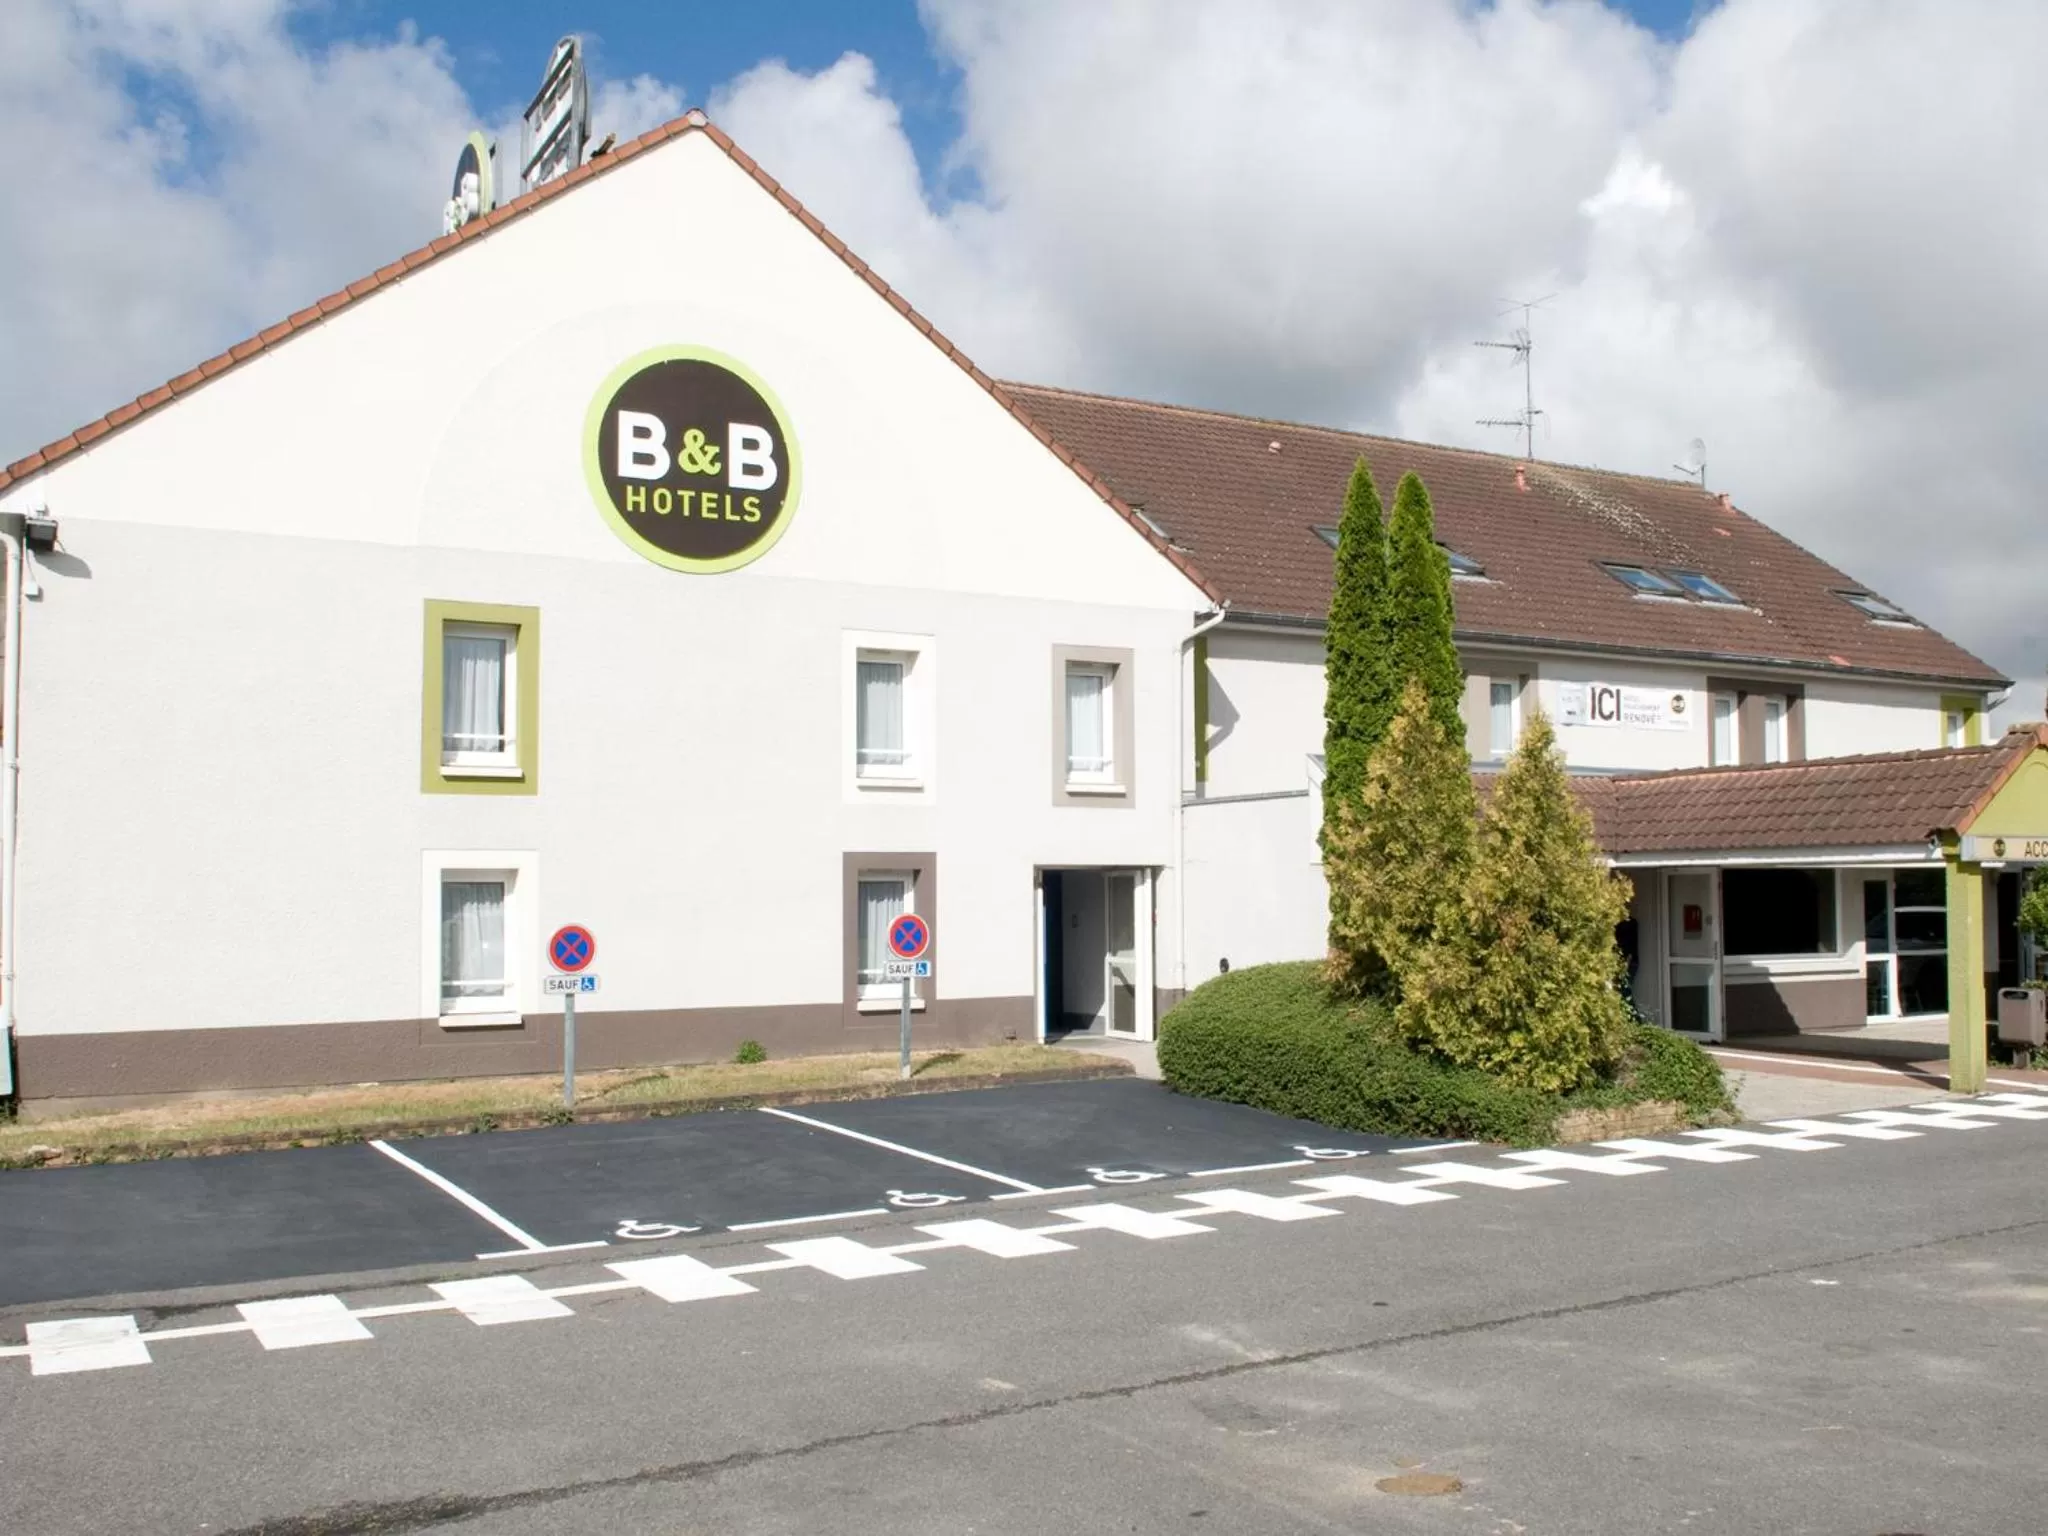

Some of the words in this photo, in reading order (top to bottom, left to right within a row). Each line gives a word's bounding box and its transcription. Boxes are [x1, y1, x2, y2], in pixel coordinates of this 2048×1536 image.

[617, 409, 778, 491] B&B
[626, 484, 762, 523] HOTELS
[1590, 686, 1621, 721] ICI
[549, 979, 579, 990] SAUF
[888, 964, 914, 974] SAUF
